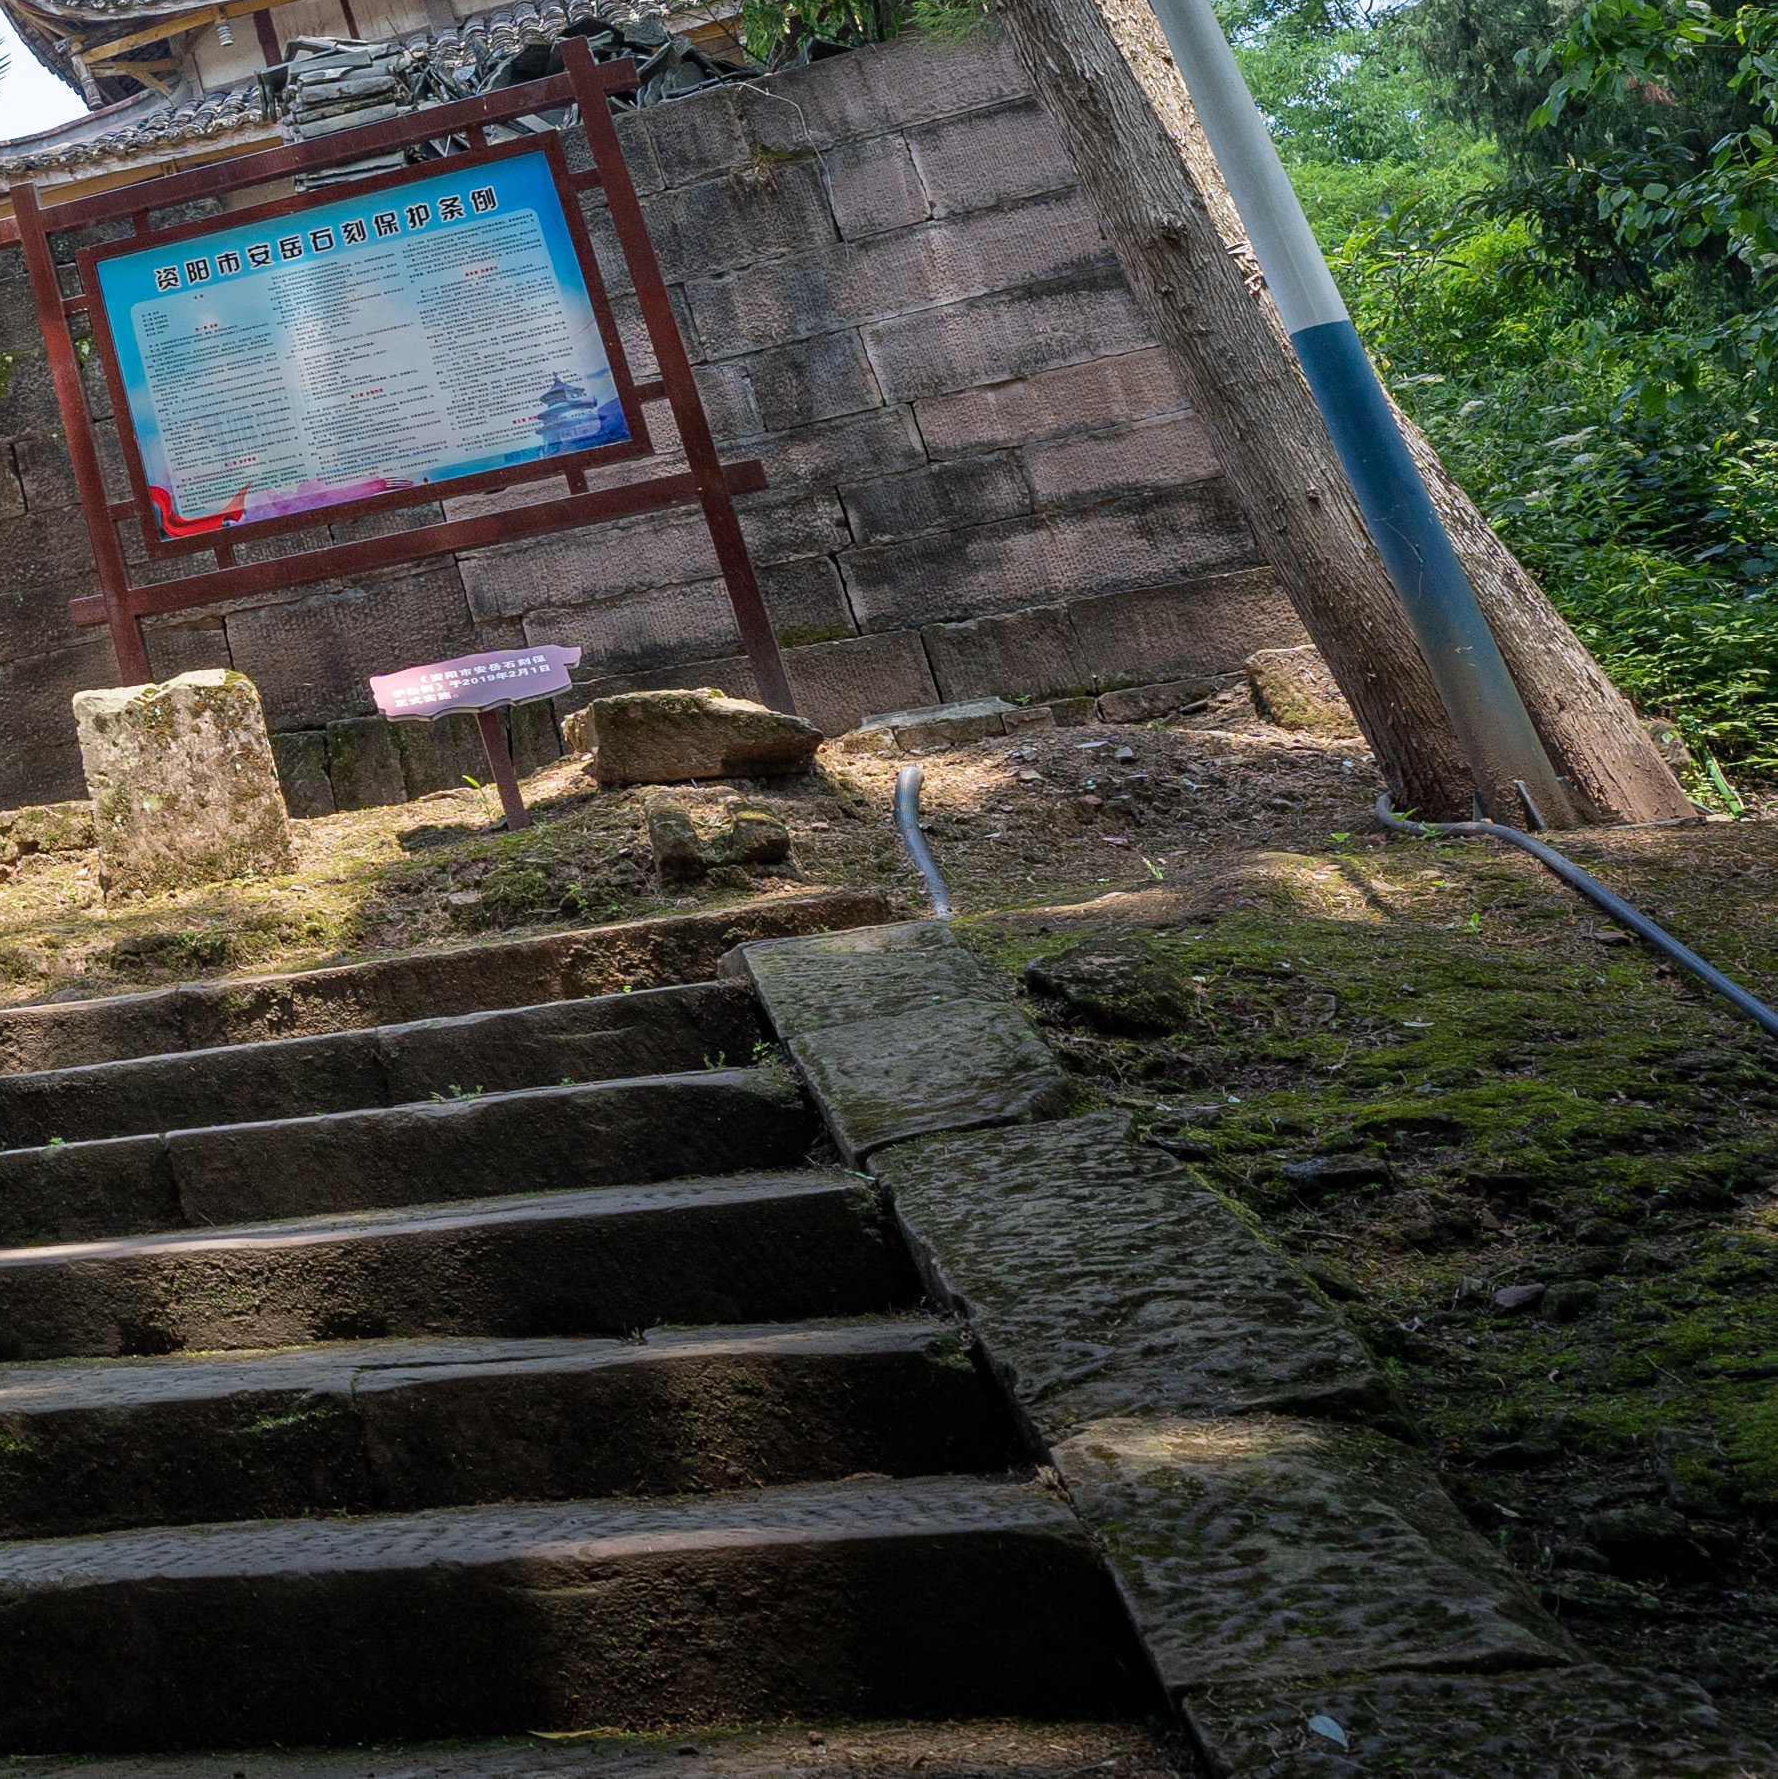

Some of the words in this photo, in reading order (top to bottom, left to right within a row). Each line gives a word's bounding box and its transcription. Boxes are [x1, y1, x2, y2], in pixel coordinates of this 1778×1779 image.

[154, 185, 499, 292] 资阳市安岳石刻保护条例
[420, 654, 547, 683] 《资阳市安岳石刻保
